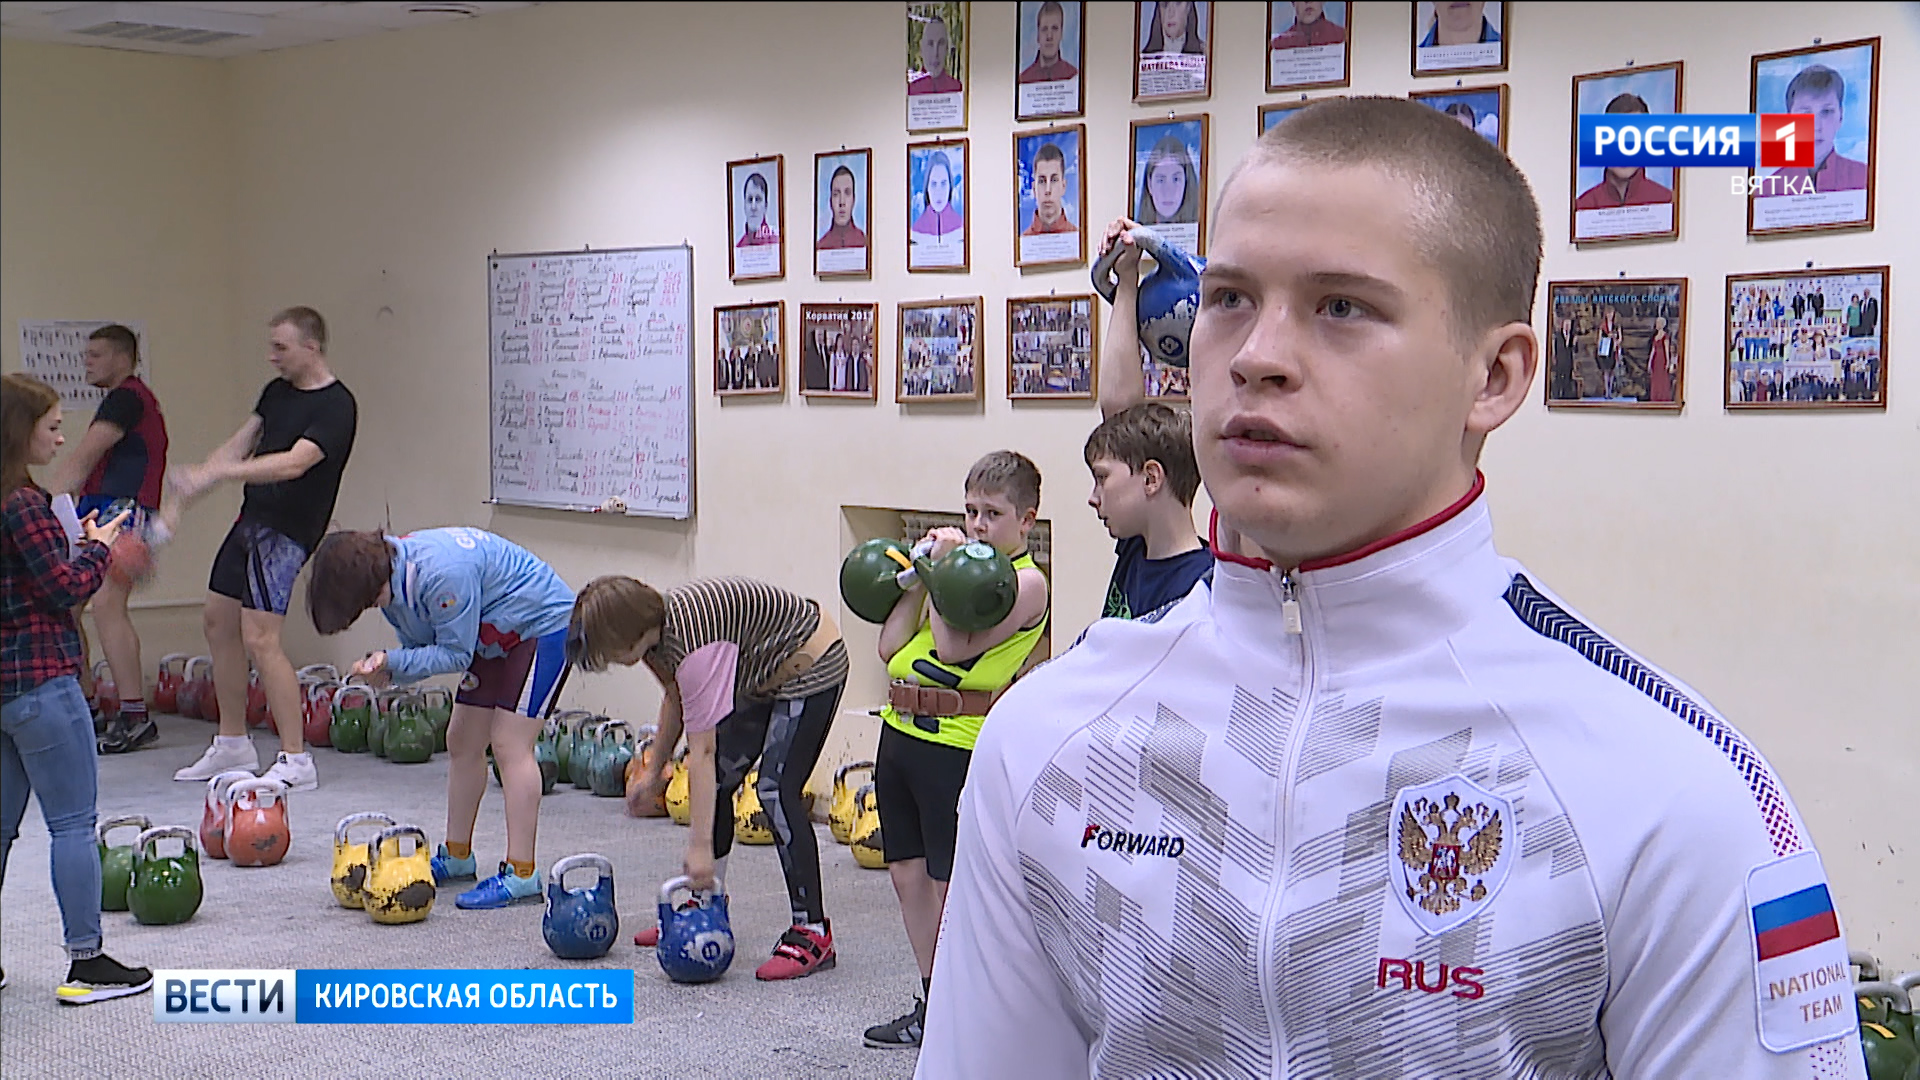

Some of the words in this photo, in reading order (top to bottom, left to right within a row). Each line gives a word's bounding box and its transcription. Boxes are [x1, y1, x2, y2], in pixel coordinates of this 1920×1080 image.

[805, 311, 849, 324] Хорватия
[1376, 957, 1485, 1001] RUS
[1769, 961, 1846, 1001] NATIONAL
[1799, 993, 1844, 1023] TEAM
